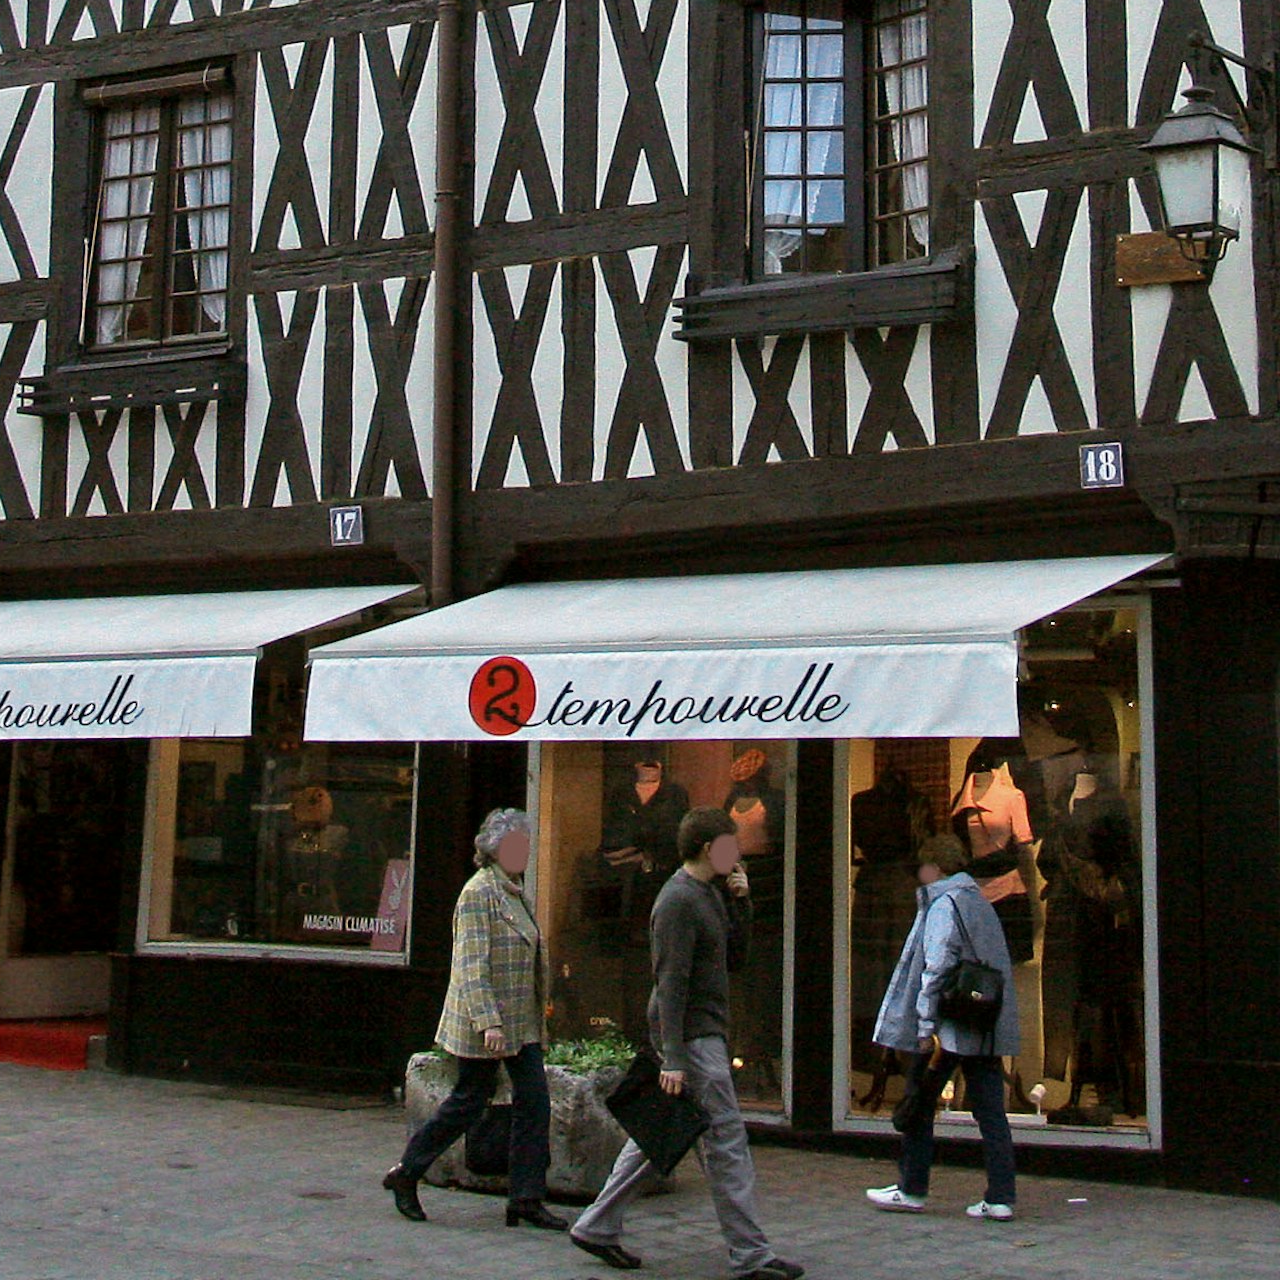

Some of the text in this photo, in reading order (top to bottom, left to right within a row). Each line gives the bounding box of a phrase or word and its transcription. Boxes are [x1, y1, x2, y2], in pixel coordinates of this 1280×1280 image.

[1086, 449, 1117, 482] 18
[335, 512, 357, 540] 17
[540, 662, 851, 737] tempourelle
[303, 914, 343, 931] MAGASIN
